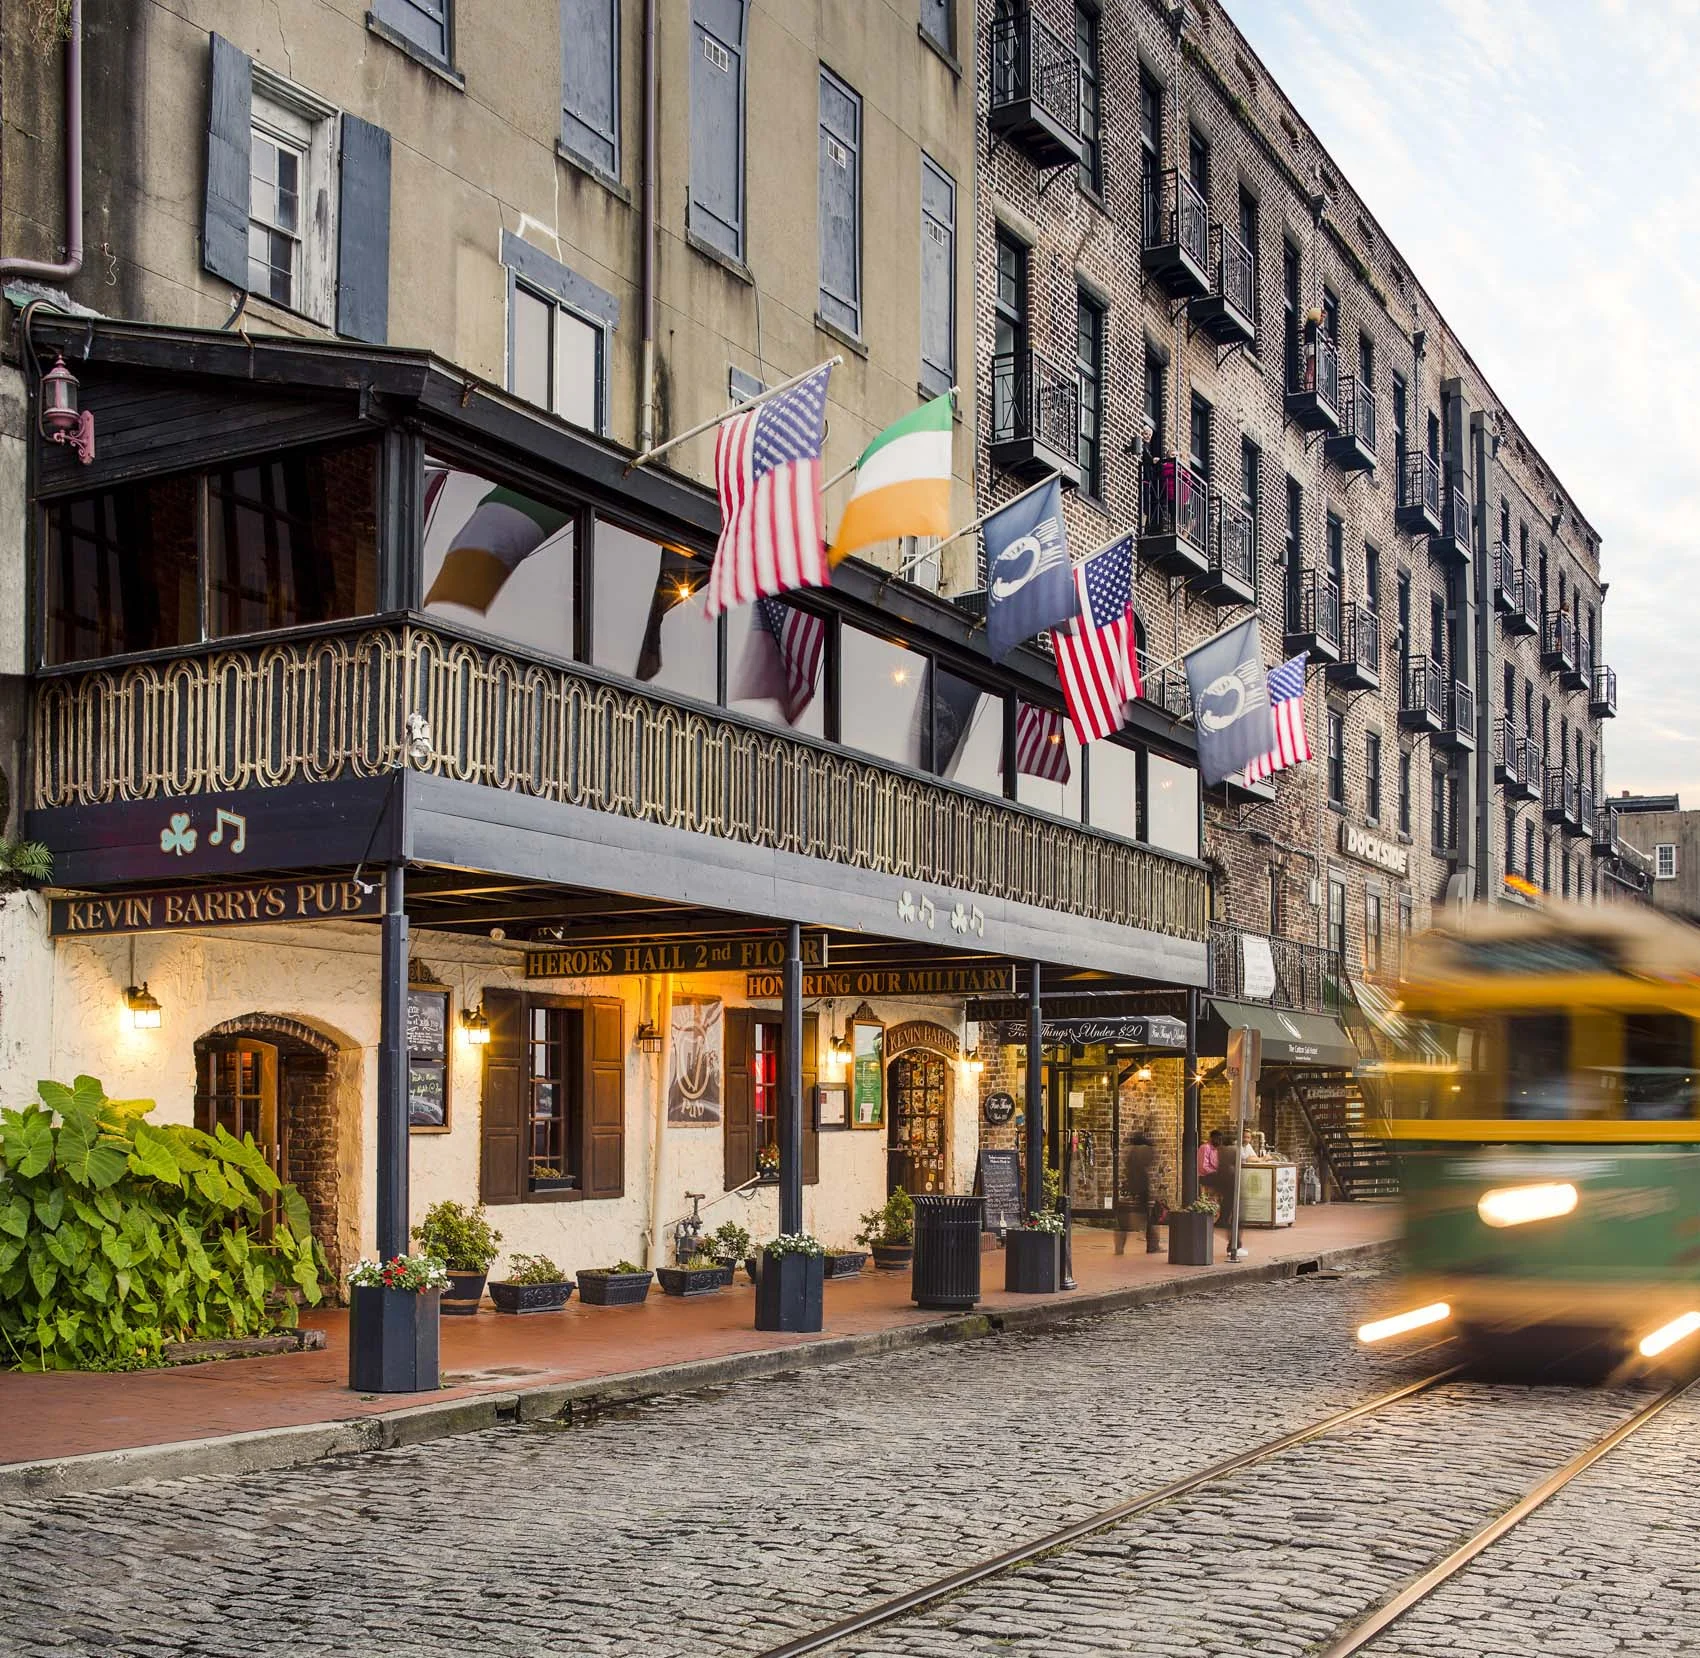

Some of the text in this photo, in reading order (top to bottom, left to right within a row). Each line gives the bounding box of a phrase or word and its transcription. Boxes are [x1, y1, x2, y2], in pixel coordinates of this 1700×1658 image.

[1347, 827, 1407, 874] DOCKSIDE
[66, 882, 363, 931] KEVIN BARRY'S PUB
[529, 941, 819, 977] HEROES HALL 2nd FLOR
[857, 972, 901, 994] OUR
[908, 969, 1010, 993] MILITARY
[890, 1026, 921, 1052] KEVIN
[1080, 1023, 1115, 1038] Under
[1118, 1023, 1143, 1040] $20
